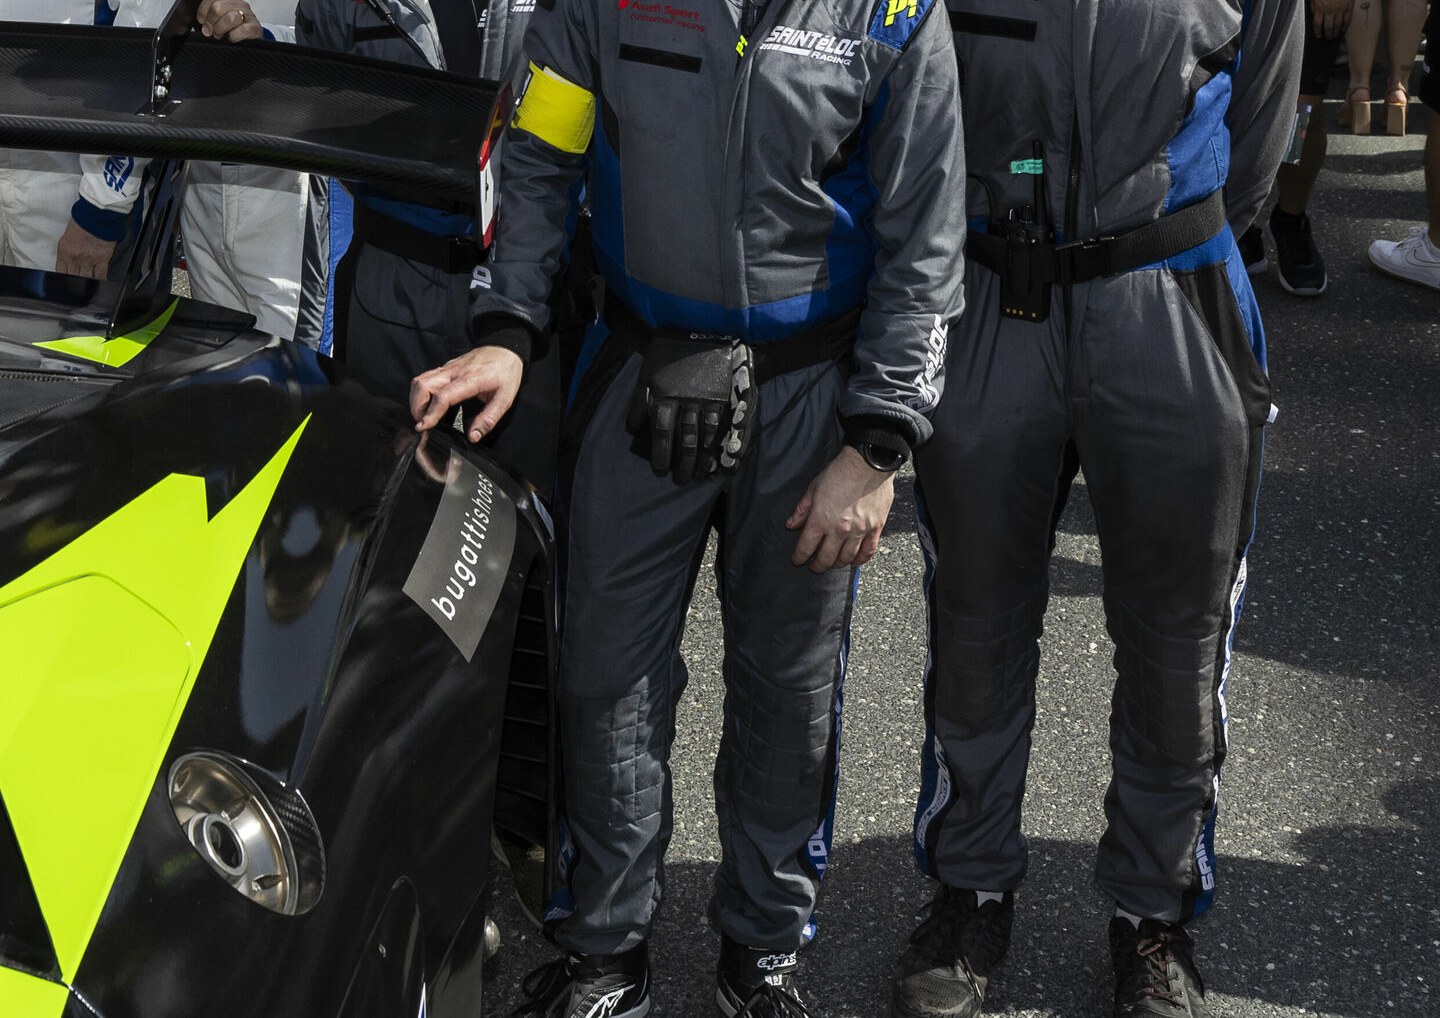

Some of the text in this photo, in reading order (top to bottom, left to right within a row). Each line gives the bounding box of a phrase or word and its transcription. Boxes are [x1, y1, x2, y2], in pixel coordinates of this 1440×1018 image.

[631, 0, 699, 20] Audi Sport
[629, 13, 705, 33] customer racing
[811, 50, 853, 66] RACING
[431, 472, 495, 622] bugattishoes
